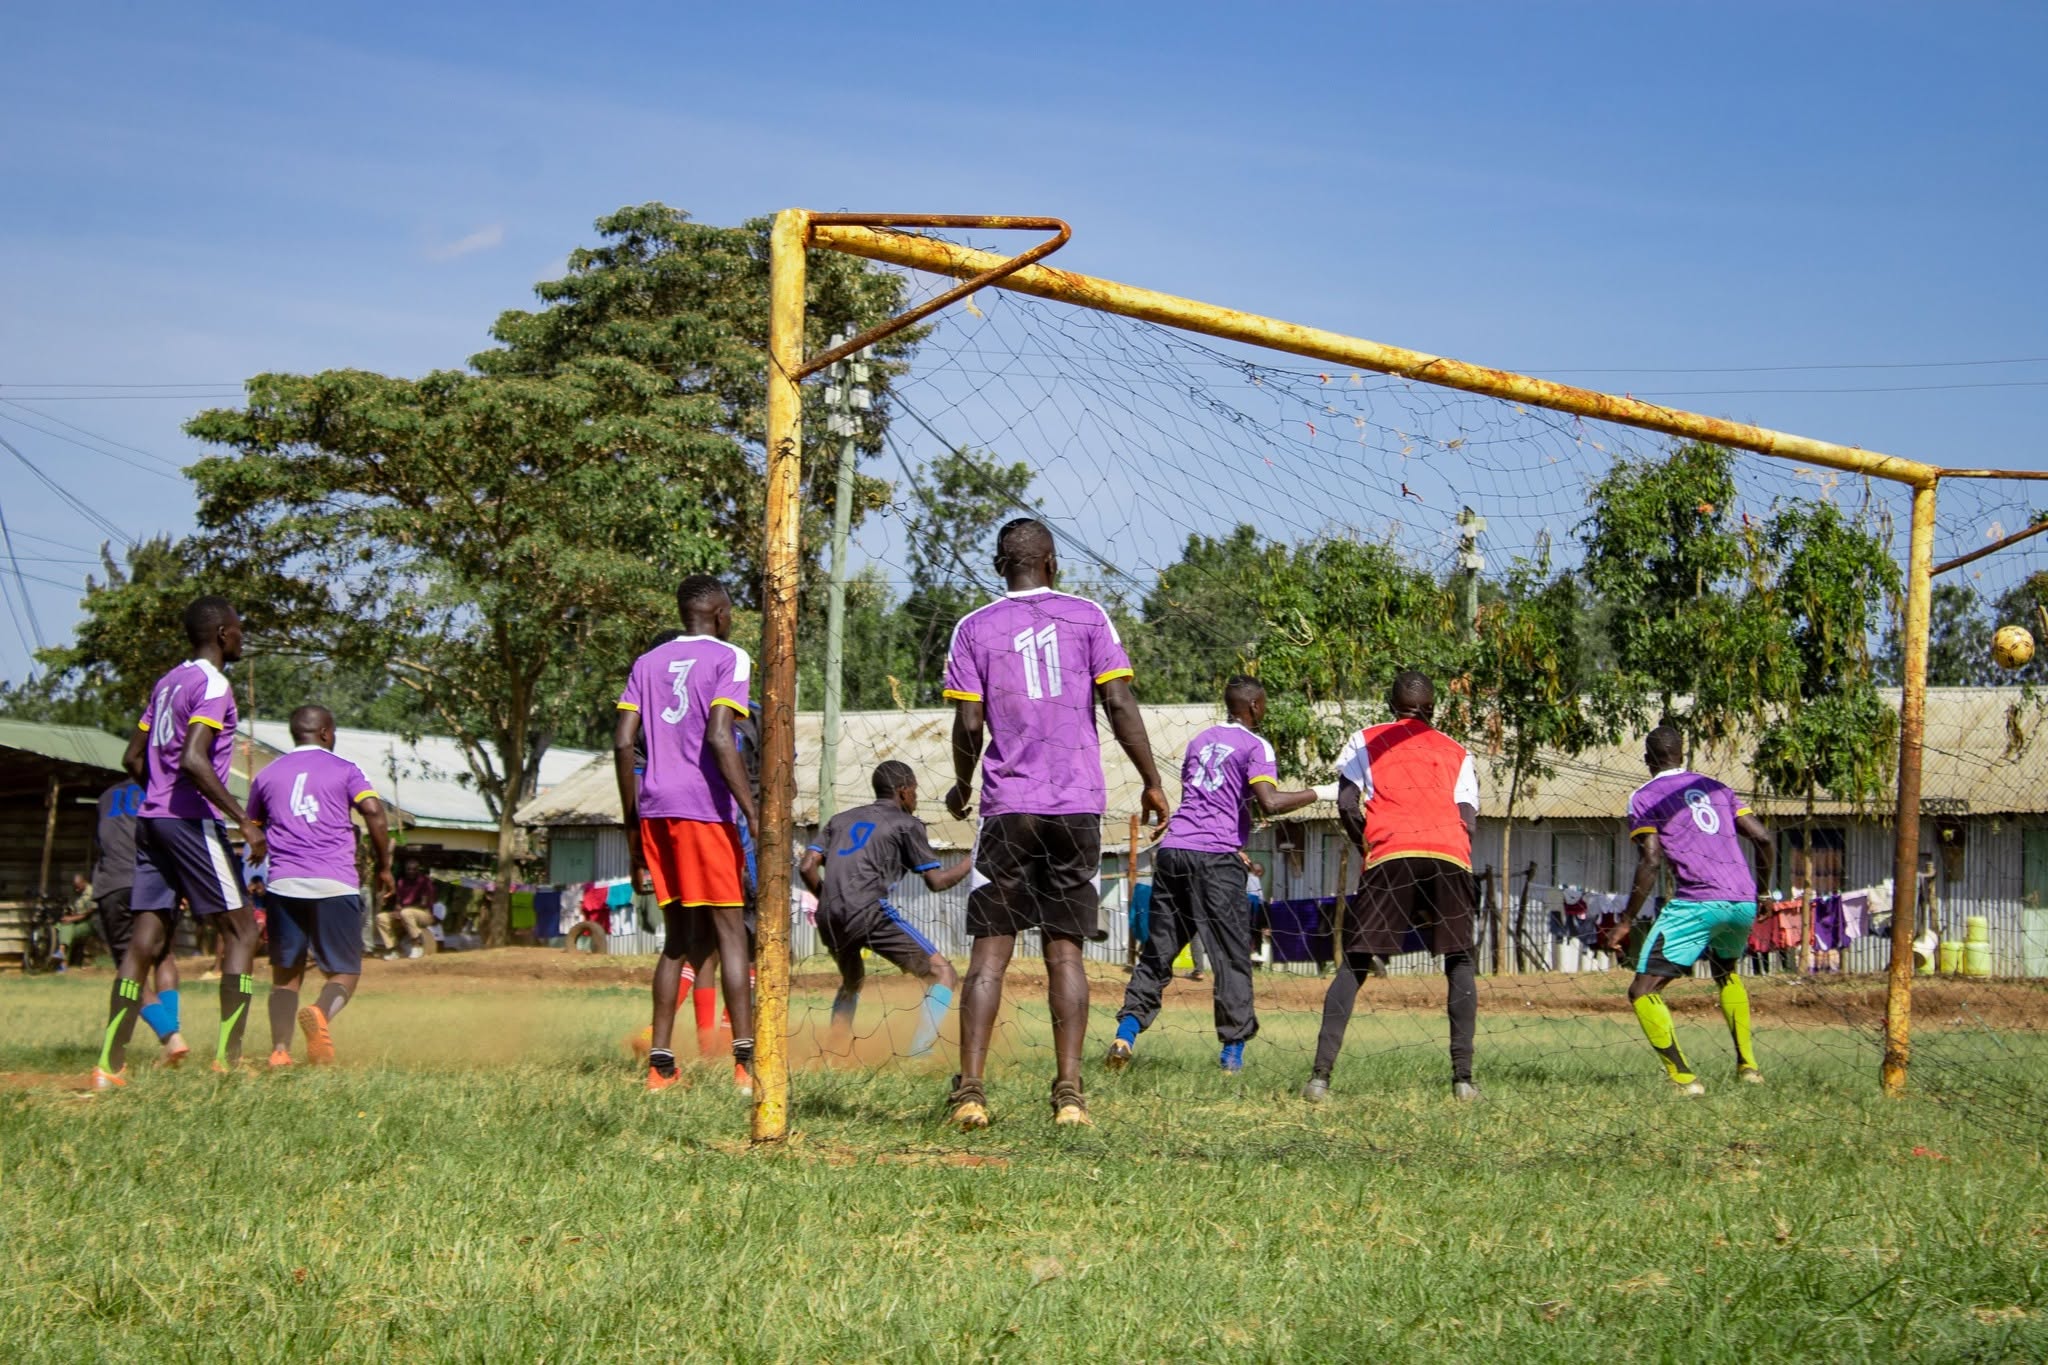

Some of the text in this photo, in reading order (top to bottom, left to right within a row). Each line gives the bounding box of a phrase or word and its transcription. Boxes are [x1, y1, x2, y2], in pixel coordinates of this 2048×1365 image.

[1013, 622, 1062, 699] 11
[660, 658, 697, 724] 3
[290, 772, 319, 823] 4
[1684, 788, 1720, 836] 8
[837, 821, 876, 857] 9
